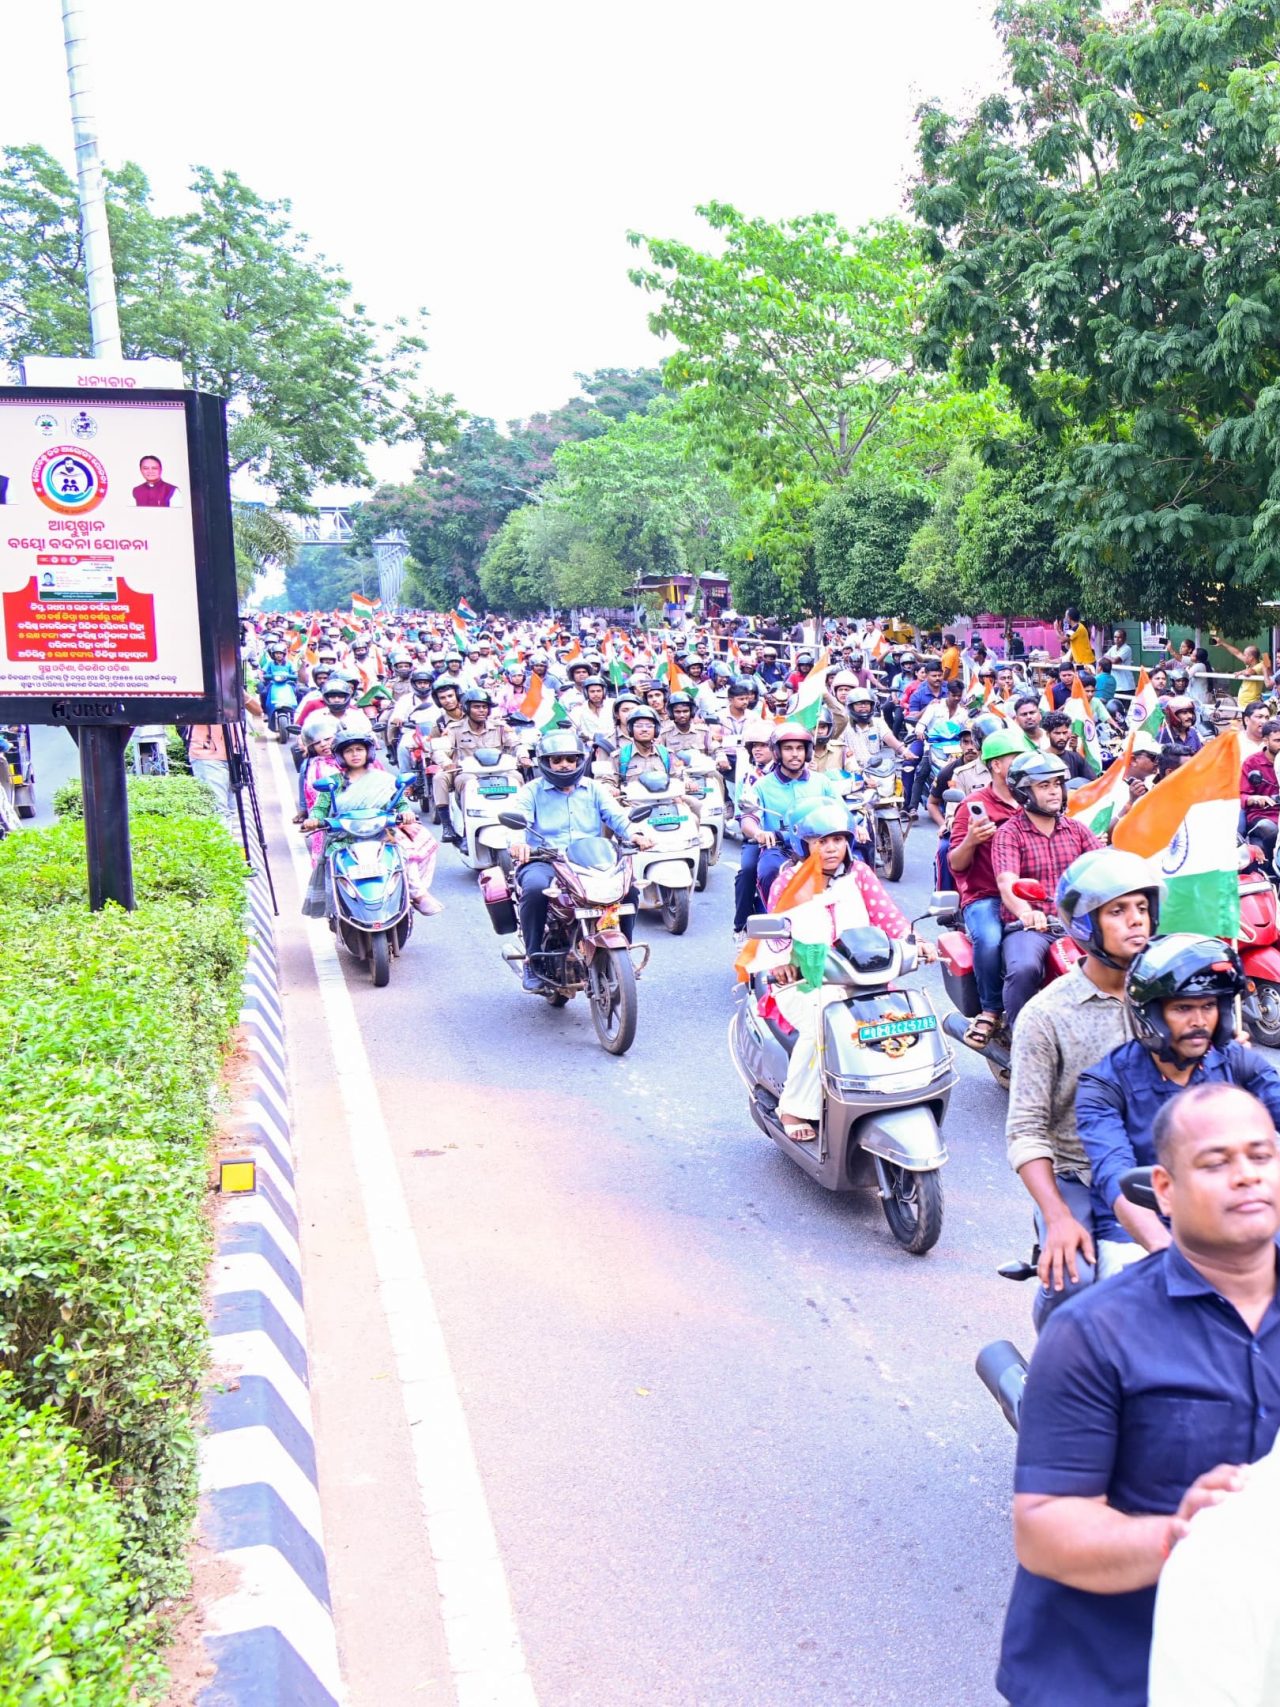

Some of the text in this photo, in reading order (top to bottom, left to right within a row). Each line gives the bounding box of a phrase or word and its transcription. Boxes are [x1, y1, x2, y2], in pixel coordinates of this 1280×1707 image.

[48, 520, 105, 538] ଆୟୁଷ୍ମାନ
[7, 538, 46, 551] ବୟୋ
[94, 539, 148, 551] ଯୋଜନା
